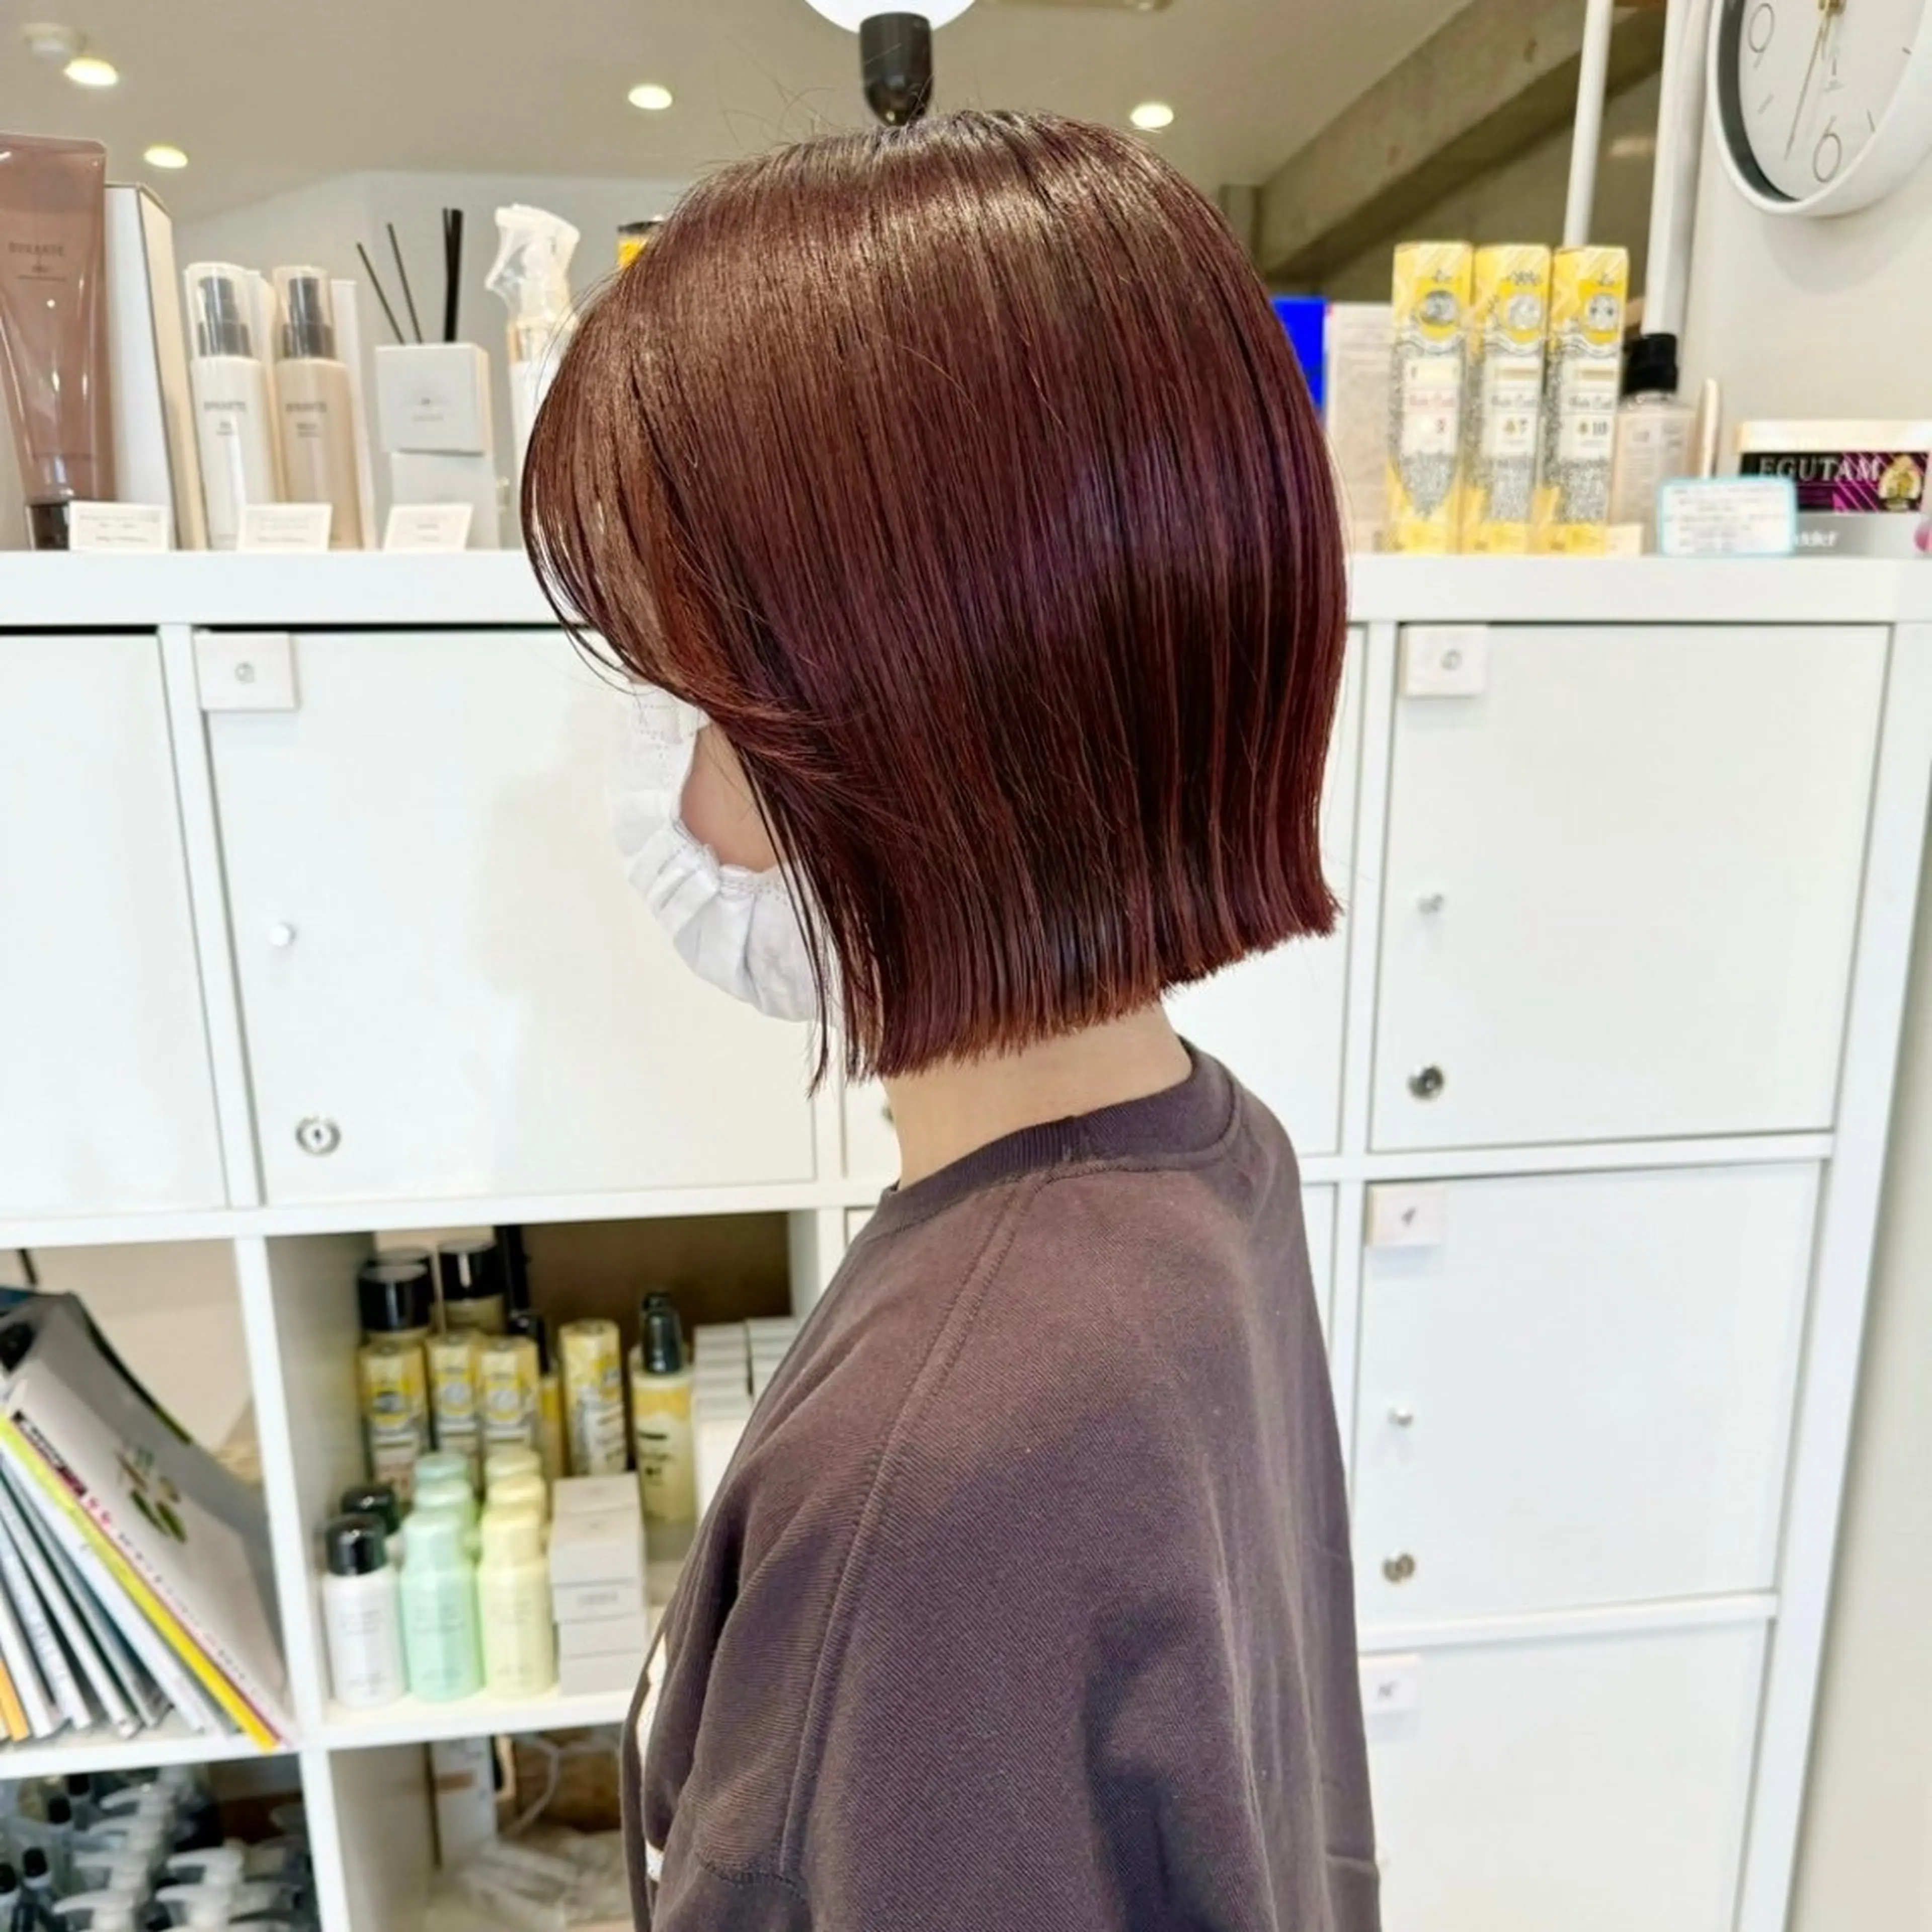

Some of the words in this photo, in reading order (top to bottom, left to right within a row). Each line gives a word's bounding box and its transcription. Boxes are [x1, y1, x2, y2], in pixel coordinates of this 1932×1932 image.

[1748, 3, 1775, 69] 9
[1812, 116, 1841, 183] 6
[1759, 456, 1882, 482] EGUTAM
